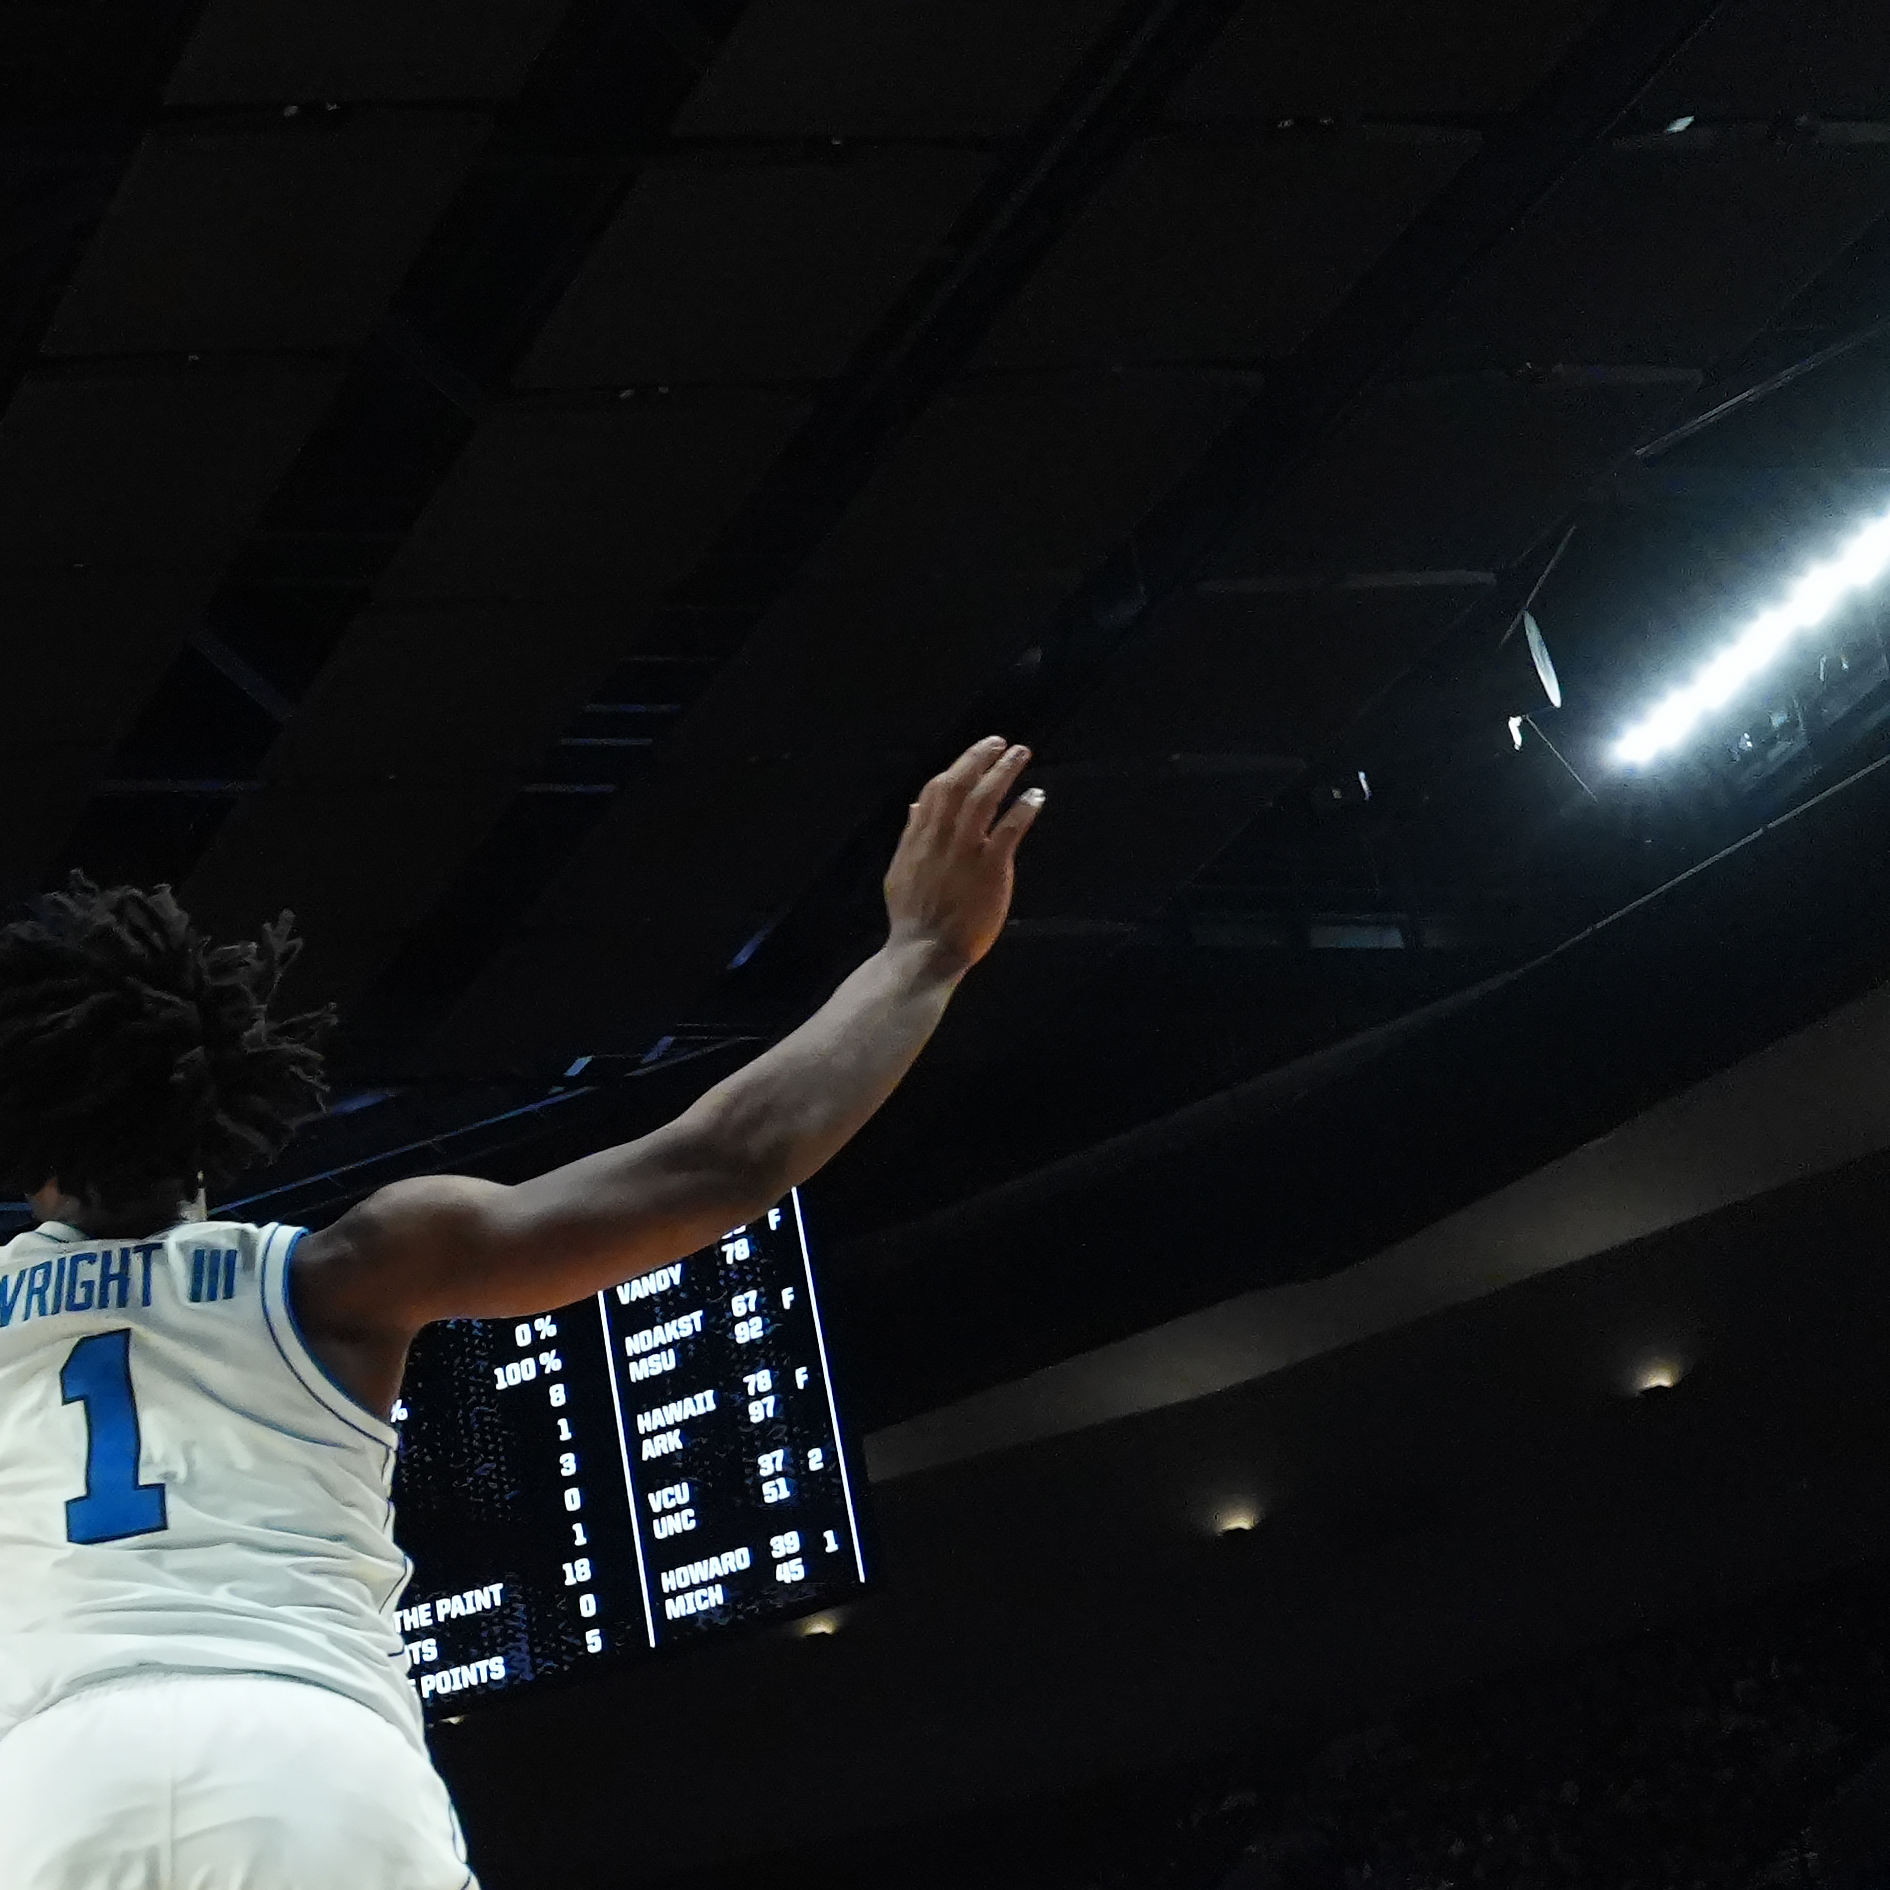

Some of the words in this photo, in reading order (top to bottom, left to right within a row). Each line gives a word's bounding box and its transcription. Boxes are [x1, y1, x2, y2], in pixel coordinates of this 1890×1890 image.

[188, 1249, 237, 1303] III
[616, 1263, 681, 1304] VANDY
[625, 1310, 703, 1356] NDAKST
[629, 1348, 676, 1382] MSU
[637, 1389, 716, 1434] HAWAII
[59, 1328, 168, 1545] 1
[642, 1428, 683, 1460] ARK
[648, 1482, 689, 1512] VCU
[653, 1508, 696, 1539] UNC
[661, 1547, 750, 1593] HOWARD
[665, 1584, 723, 1619] MICH
